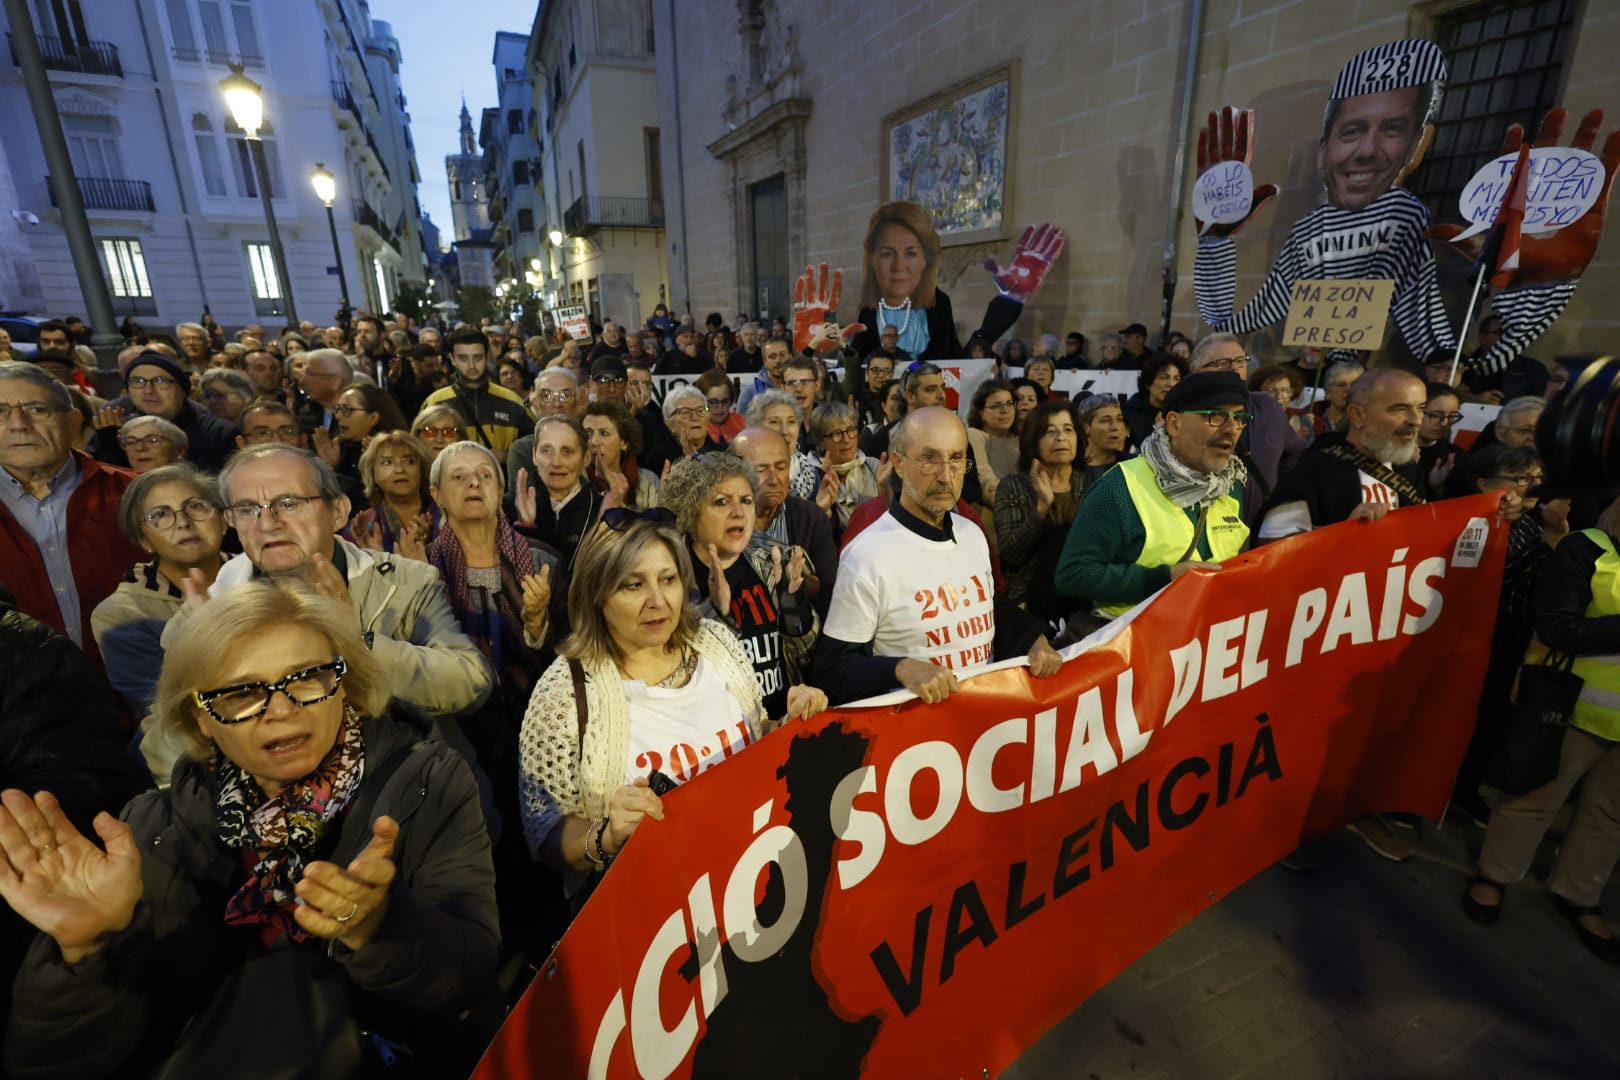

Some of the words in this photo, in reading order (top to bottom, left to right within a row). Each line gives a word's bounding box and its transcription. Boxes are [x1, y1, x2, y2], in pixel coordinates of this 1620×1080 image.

[1366, 54, 1411, 81] 228
[1225, 164, 1243, 183] LO
[1203, 180, 1243, 204] HABEIS
[1469, 177, 1593, 203] MINTEN
[1472, 205, 1553, 224] MEOS
[1303, 304, 1315, 319] A
[1331, 305, 1358, 319] LA
[1292, 324, 1374, 344] PRESÓ
[914, 575, 993, 621] 20:1
[925, 625, 952, 648] NI
[929, 653, 954, 671] NI
[831, 668, 1154, 891] SOCIAL
[1162, 608, 1269, 727] DEL
[1284, 547, 1447, 668] PAÍS
[869, 711, 1283, 1018] VALENCIÀ
